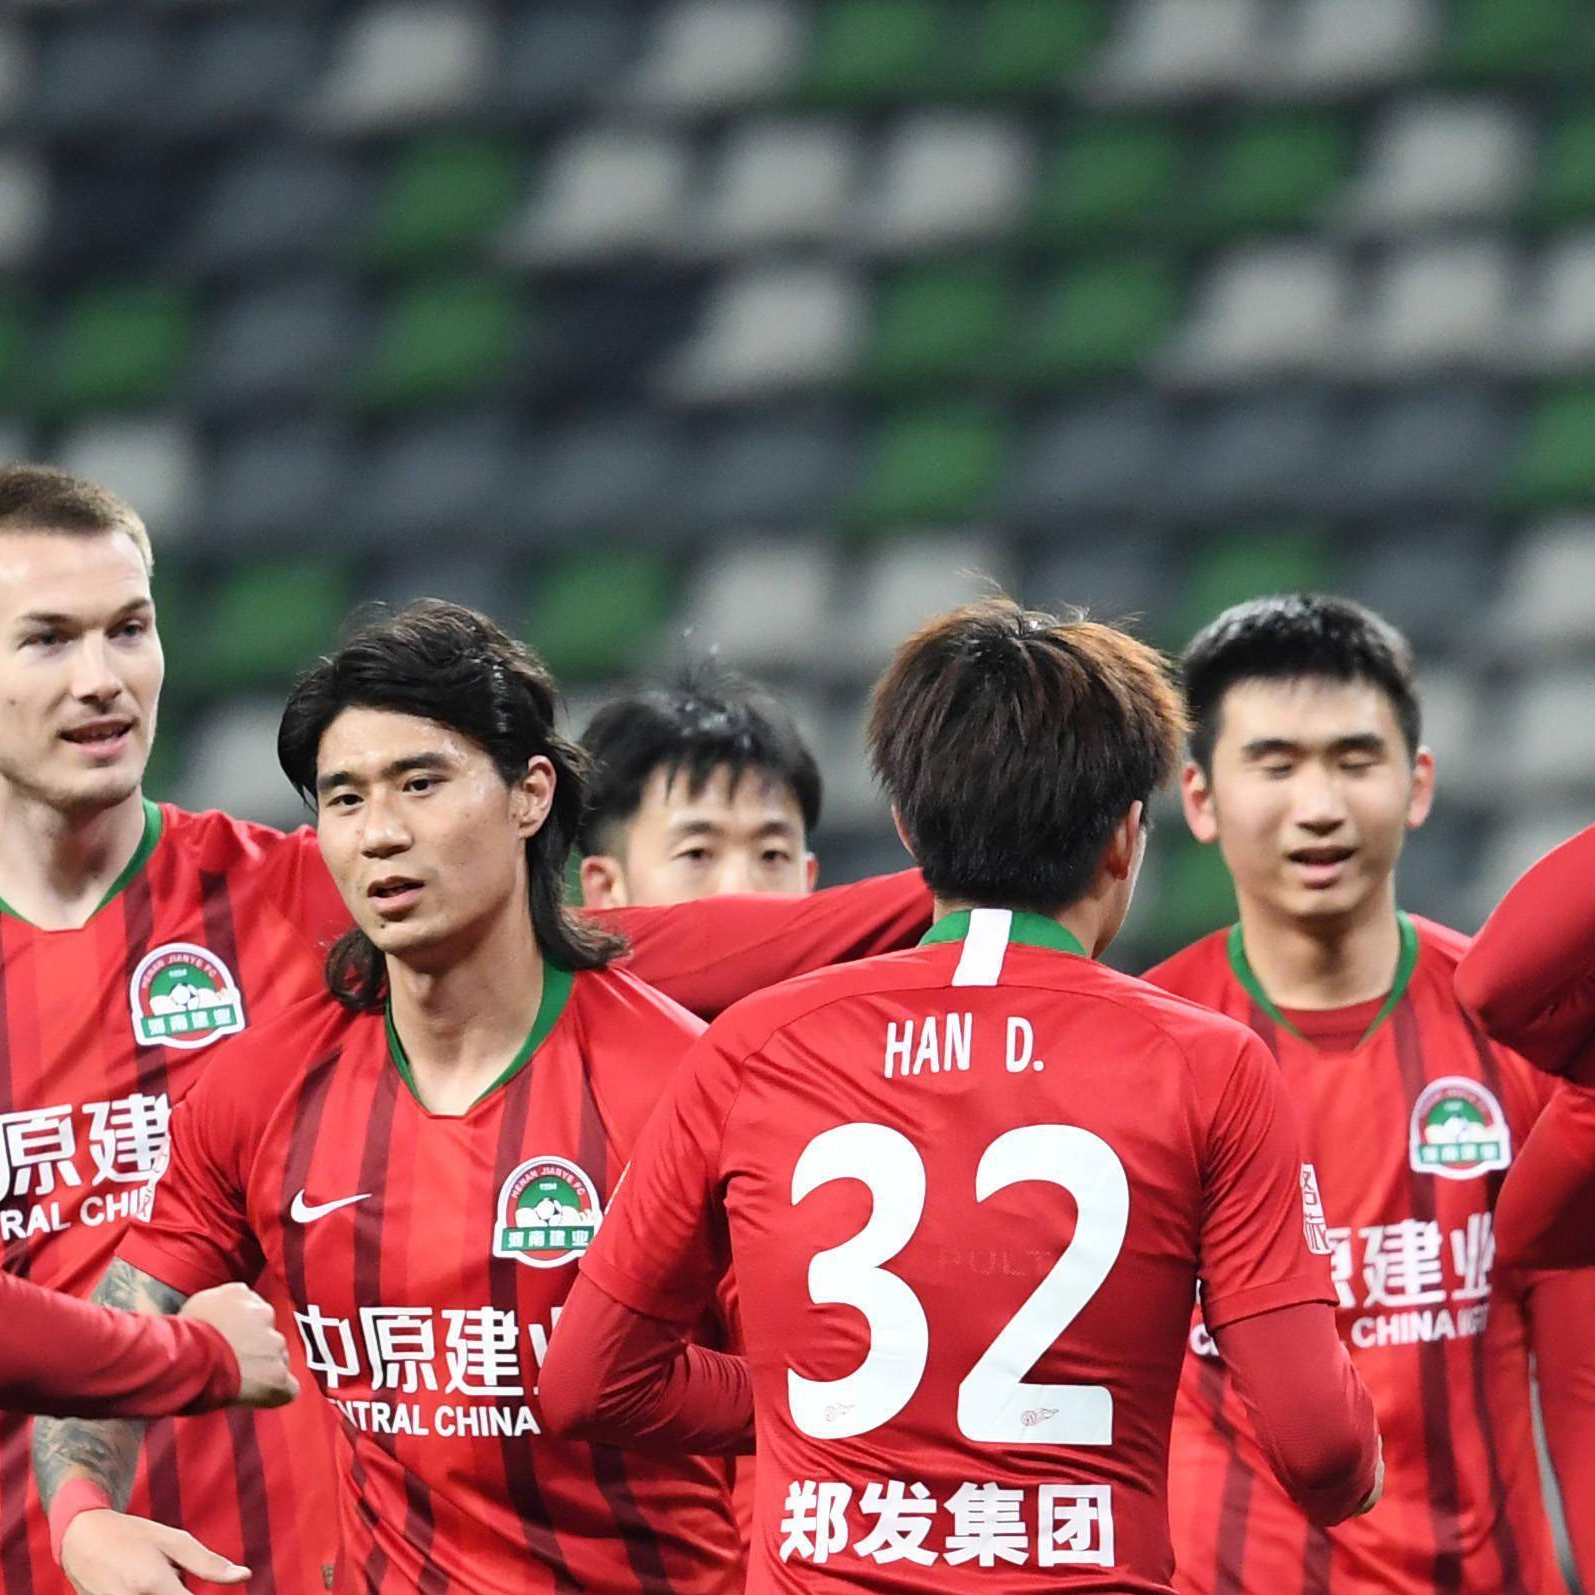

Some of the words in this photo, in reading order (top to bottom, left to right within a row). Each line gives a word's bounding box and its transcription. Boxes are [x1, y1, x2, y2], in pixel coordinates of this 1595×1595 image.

[884, 1012, 973, 1079] HAN
[1006, 1016, 1044, 1072] D.
[787, 1122, 1130, 1446] 32
[434, 1405, 541, 1437] CHINA
[780, 1480, 1115, 1567] 郑发集团
